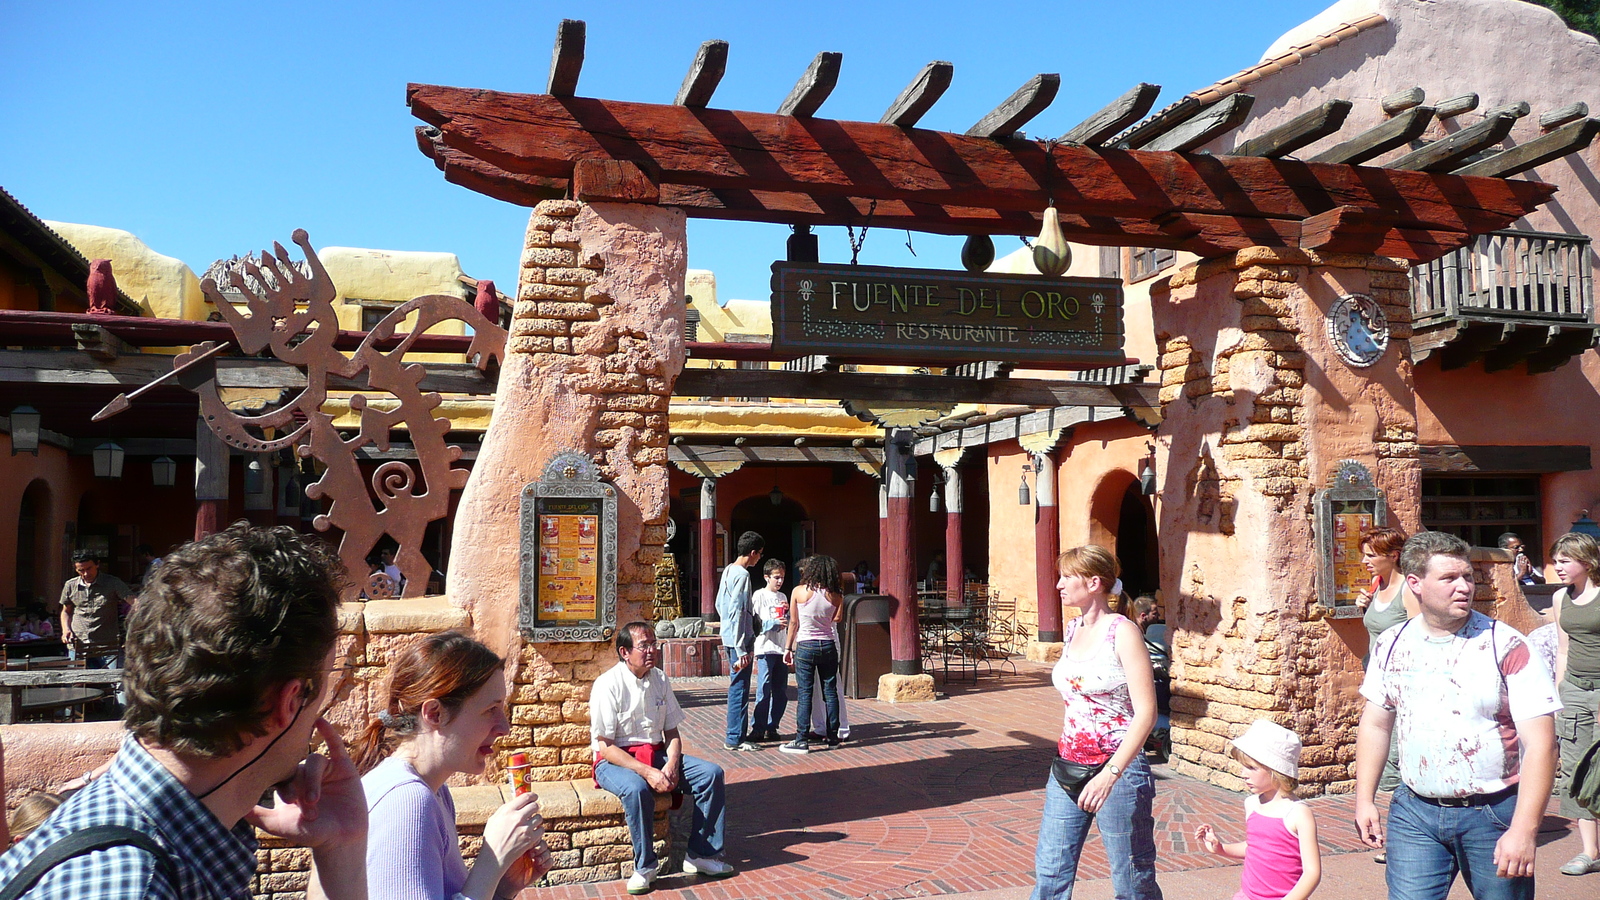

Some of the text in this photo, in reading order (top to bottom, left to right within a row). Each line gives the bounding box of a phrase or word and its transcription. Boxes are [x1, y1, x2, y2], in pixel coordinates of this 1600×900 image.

[830, 281, 1080, 320] FUENTE DEL ORO
[896, 322, 1020, 343] RESTAURANTE
